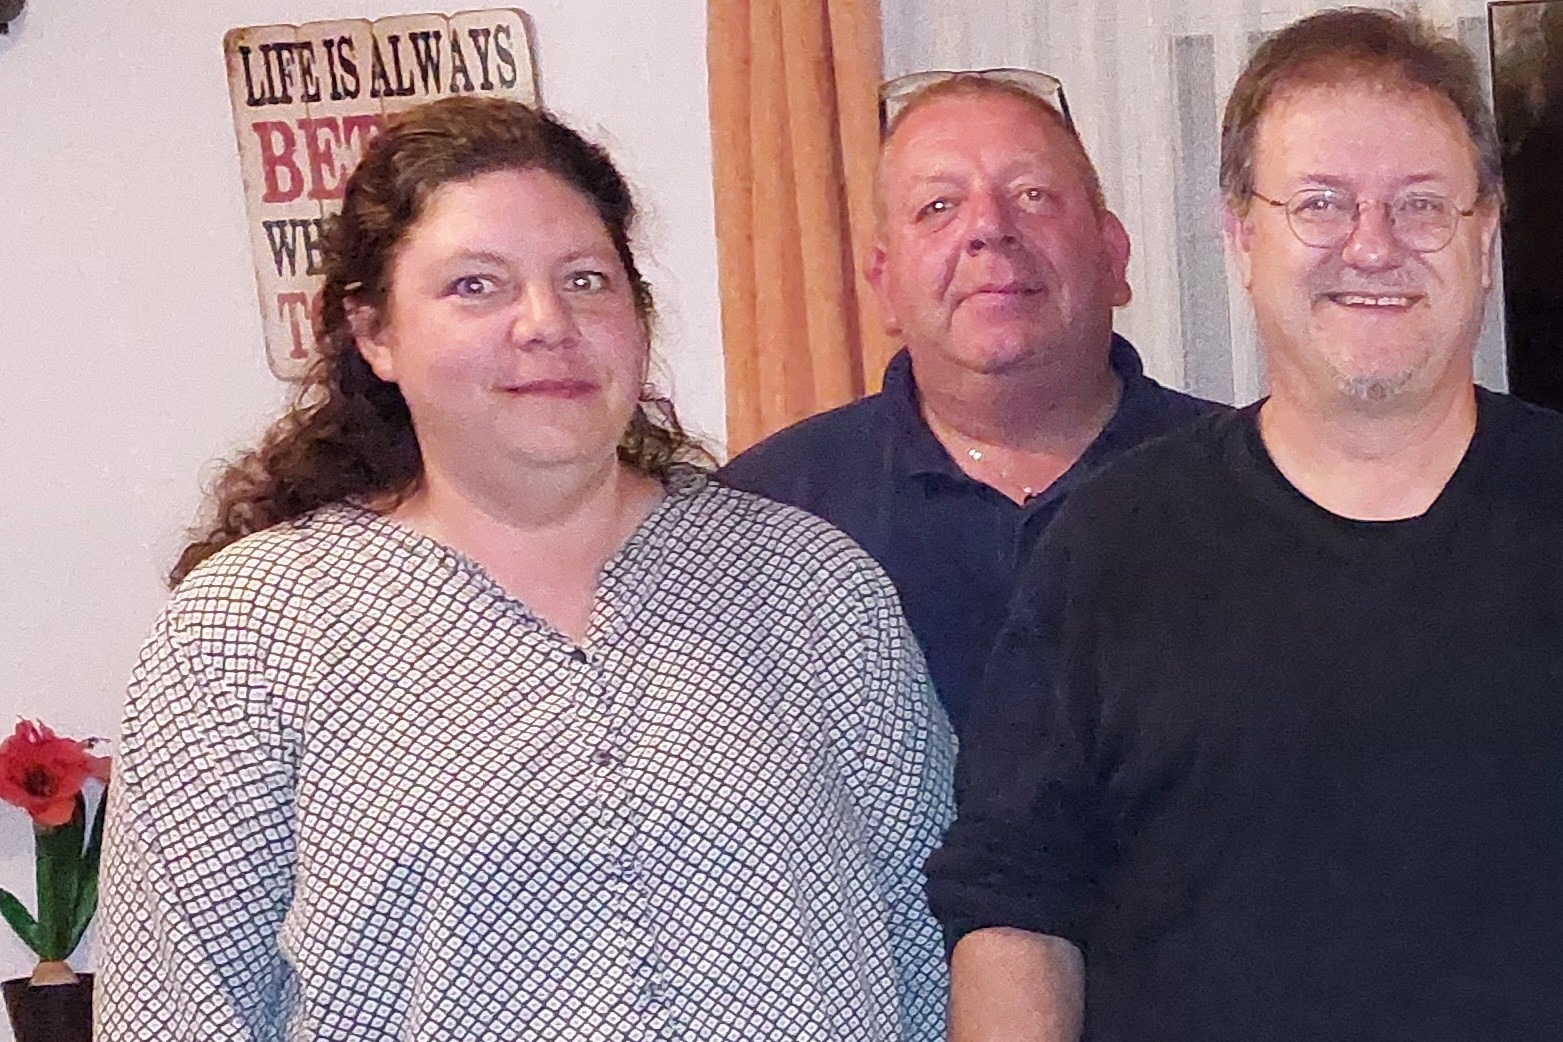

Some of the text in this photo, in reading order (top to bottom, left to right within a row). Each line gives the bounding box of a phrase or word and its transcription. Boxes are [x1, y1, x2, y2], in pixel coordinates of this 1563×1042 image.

[238, 24, 517, 107] LIFE IS ALWAYS
